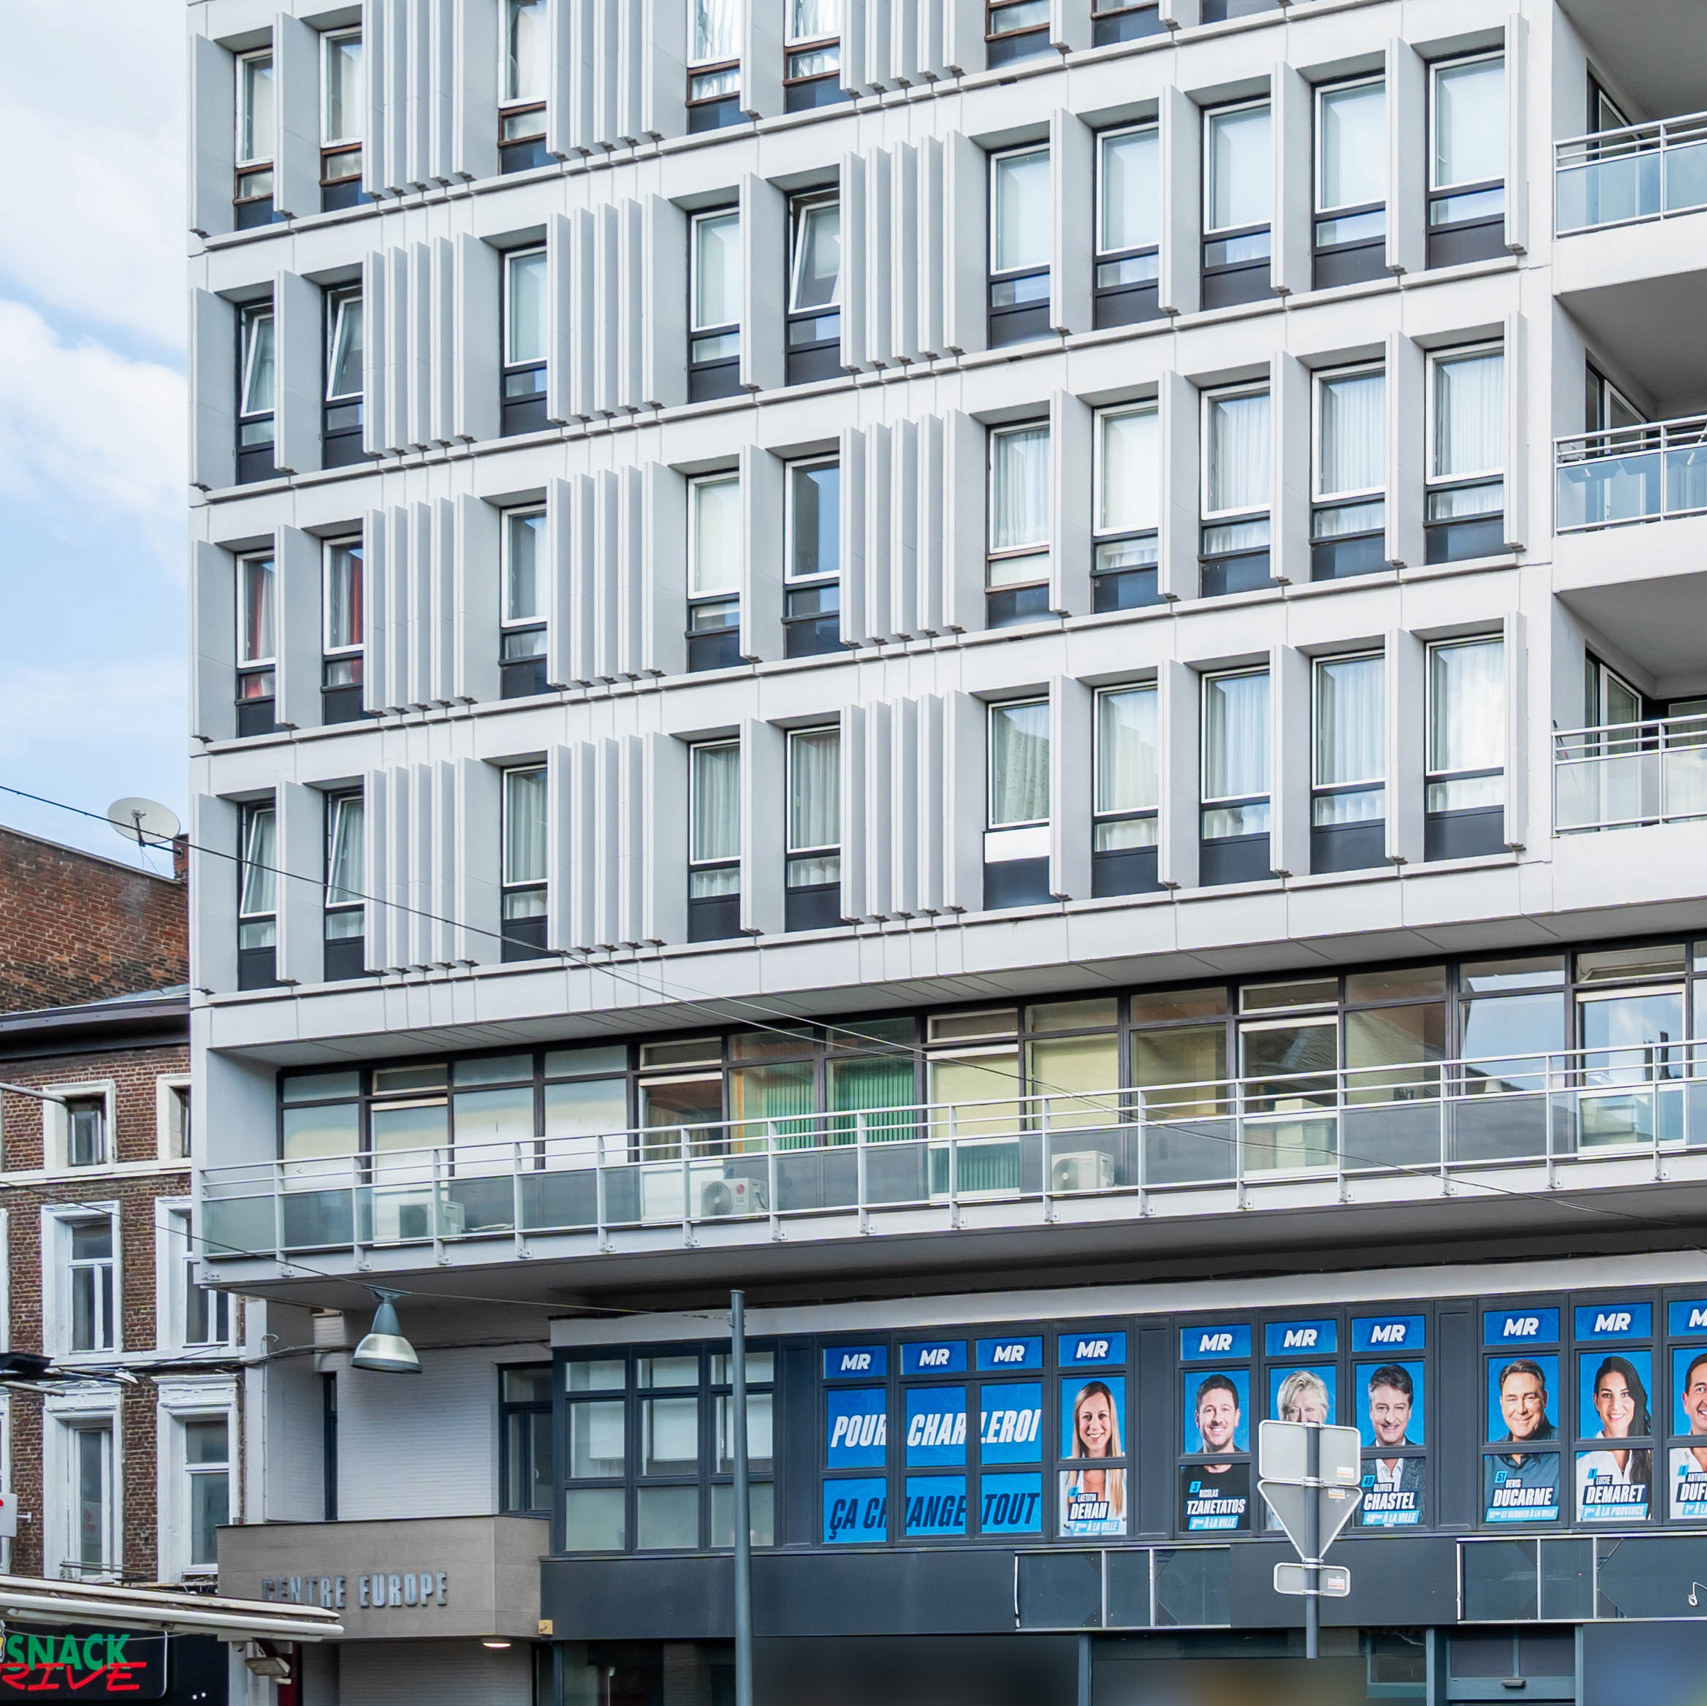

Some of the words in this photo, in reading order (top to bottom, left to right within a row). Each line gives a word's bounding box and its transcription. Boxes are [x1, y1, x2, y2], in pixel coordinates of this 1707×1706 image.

[1370, 1322, 1406, 1345] MR
[1502, 1316, 1540, 1337] MR
[1595, 1313, 1632, 1334] MR
[1199, 1331, 1232, 1352] MR
[1284, 1328, 1318, 1348] MR
[919, 1348, 950, 1366] MR
[993, 1344, 1026, 1363] MR
[1076, 1340, 1108, 1359] MR
[841, 1353, 871, 1371] MR
[830, 1414, 887, 1448] POUR
[1363, 1492, 1415, 1511] CHASTEL
[1492, 1487, 1553, 1507] DUCARME
[1586, 1484, 1645, 1504] DEMARET
[829, 1498, 859, 1541] ÇA
[984, 1492, 1041, 1526] TOUT
[1070, 1502, 1108, 1520] DEHAN
[1187, 1499, 1246, 1515] TZANETATOS
[261, 1574, 346, 1610] CENTRE
[358, 1571, 449, 1609] EUROPE
[7, 1633, 131, 1671] SNACK
